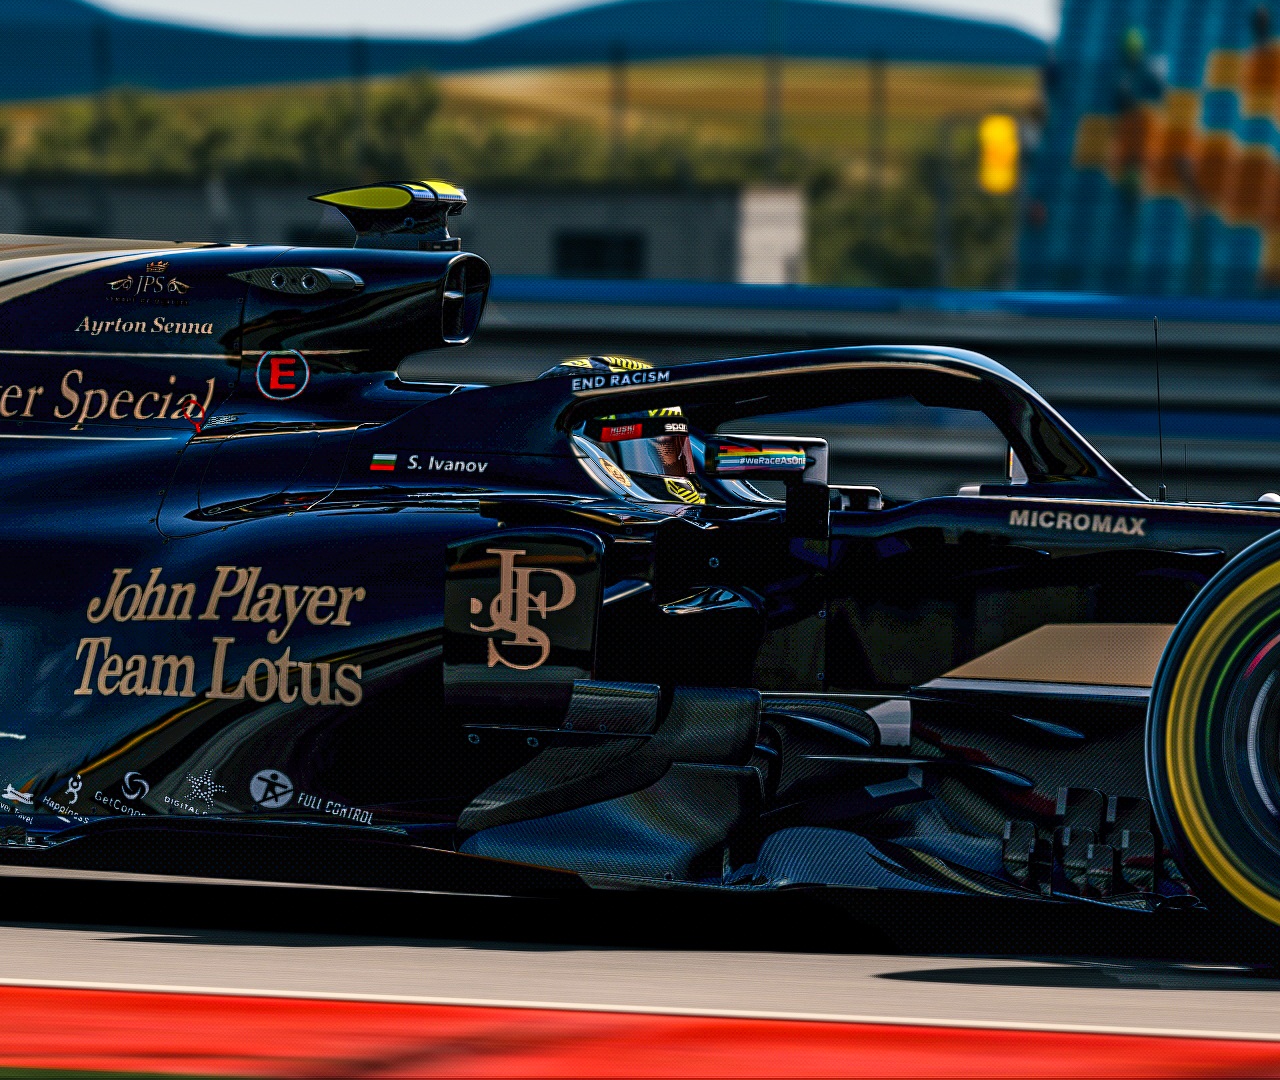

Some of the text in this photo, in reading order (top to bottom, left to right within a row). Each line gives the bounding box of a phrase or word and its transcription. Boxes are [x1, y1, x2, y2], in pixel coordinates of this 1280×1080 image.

[133, 275, 165, 297] JPS
[74, 315, 213, 336] Ayrton Senna
[270, 357, 296, 390] E
[571, 370, 671, 391] END RACISM
[53, 369, 216, 433] Special
[407, 454, 489, 474] S. Ivanov
[1008, 508, 1146, 537] MICROMAX
[86, 565, 366, 644] John Player
[74, 636, 365, 707] Team Lotus
[297, 792, 373, 825] FULL CONTROL
